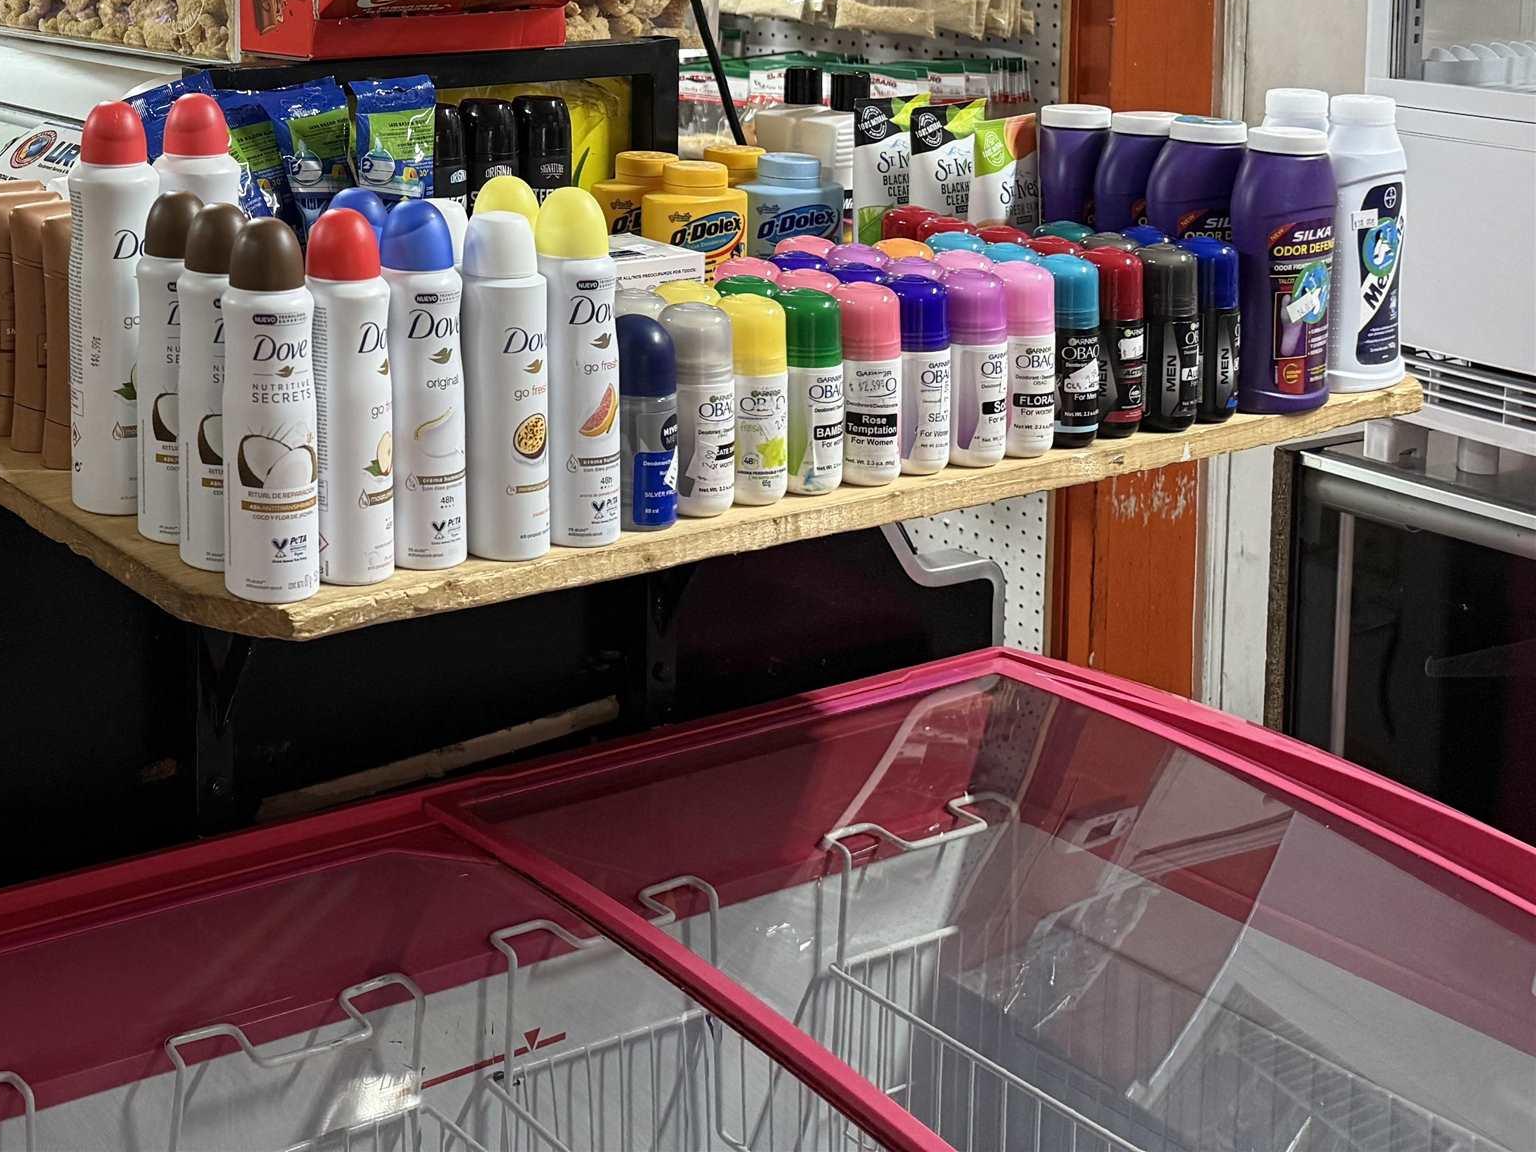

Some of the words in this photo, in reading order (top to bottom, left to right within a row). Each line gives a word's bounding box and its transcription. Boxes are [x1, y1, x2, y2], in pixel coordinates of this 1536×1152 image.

[1204, 218, 1231, 229] SIL
[1292, 226, 1332, 242] SILKA
[1274, 244, 1307, 256] ODOR
[578, 281, 598, 289] NUEVO
[415, 295, 438, 303] NUEVO
[568, 296, 615, 325] Dov
[503, 327, 547, 354] Dov
[253, 334, 308, 362] Dove
[584, 362, 600, 375] go
[1221, 348, 1230, 384] MEN
[1100, 359, 1108, 396] MEN
[1167, 355, 1177, 391] MEN
[252, 380, 310, 392] NUTRITIVE
[426, 375, 460, 392] original
[252, 388, 312, 404] SECRETS
[514, 389, 530, 401] go
[532, 384, 548, 396] fres
[1074, 393, 1086, 401] For
[862, 415, 887, 424] Rose
[989, 416, 998, 424] For
[848, 423, 897, 434] Temptation
[920, 430, 932, 438] For
[822, 440, 832, 448] For
[851, 436, 865, 445] For
[645, 489, 664, 498] SILVER
[440, 496, 454, 504] 48h
